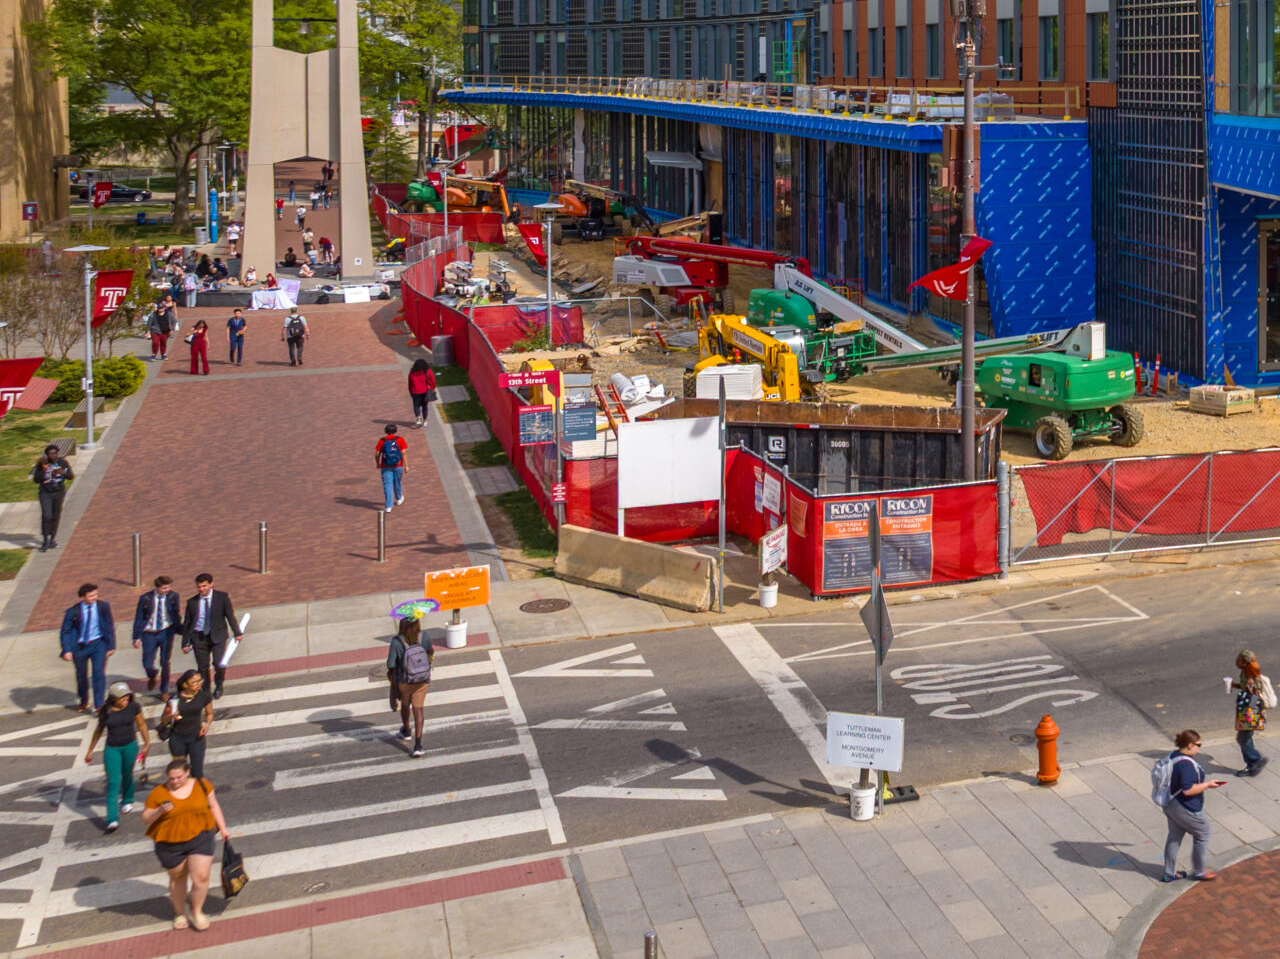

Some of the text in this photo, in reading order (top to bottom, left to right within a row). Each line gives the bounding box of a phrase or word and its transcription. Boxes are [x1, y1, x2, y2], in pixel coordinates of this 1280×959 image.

[831, 502, 870, 515] RYCON
[887, 498, 927, 510] RYCON
[847, 724, 882, 733] TUTTLEMAN
[836, 730, 891, 741] LEARNING CENTER
[841, 743, 885, 754] MONTGOMERY
[851, 752, 875, 760] AVENUE
